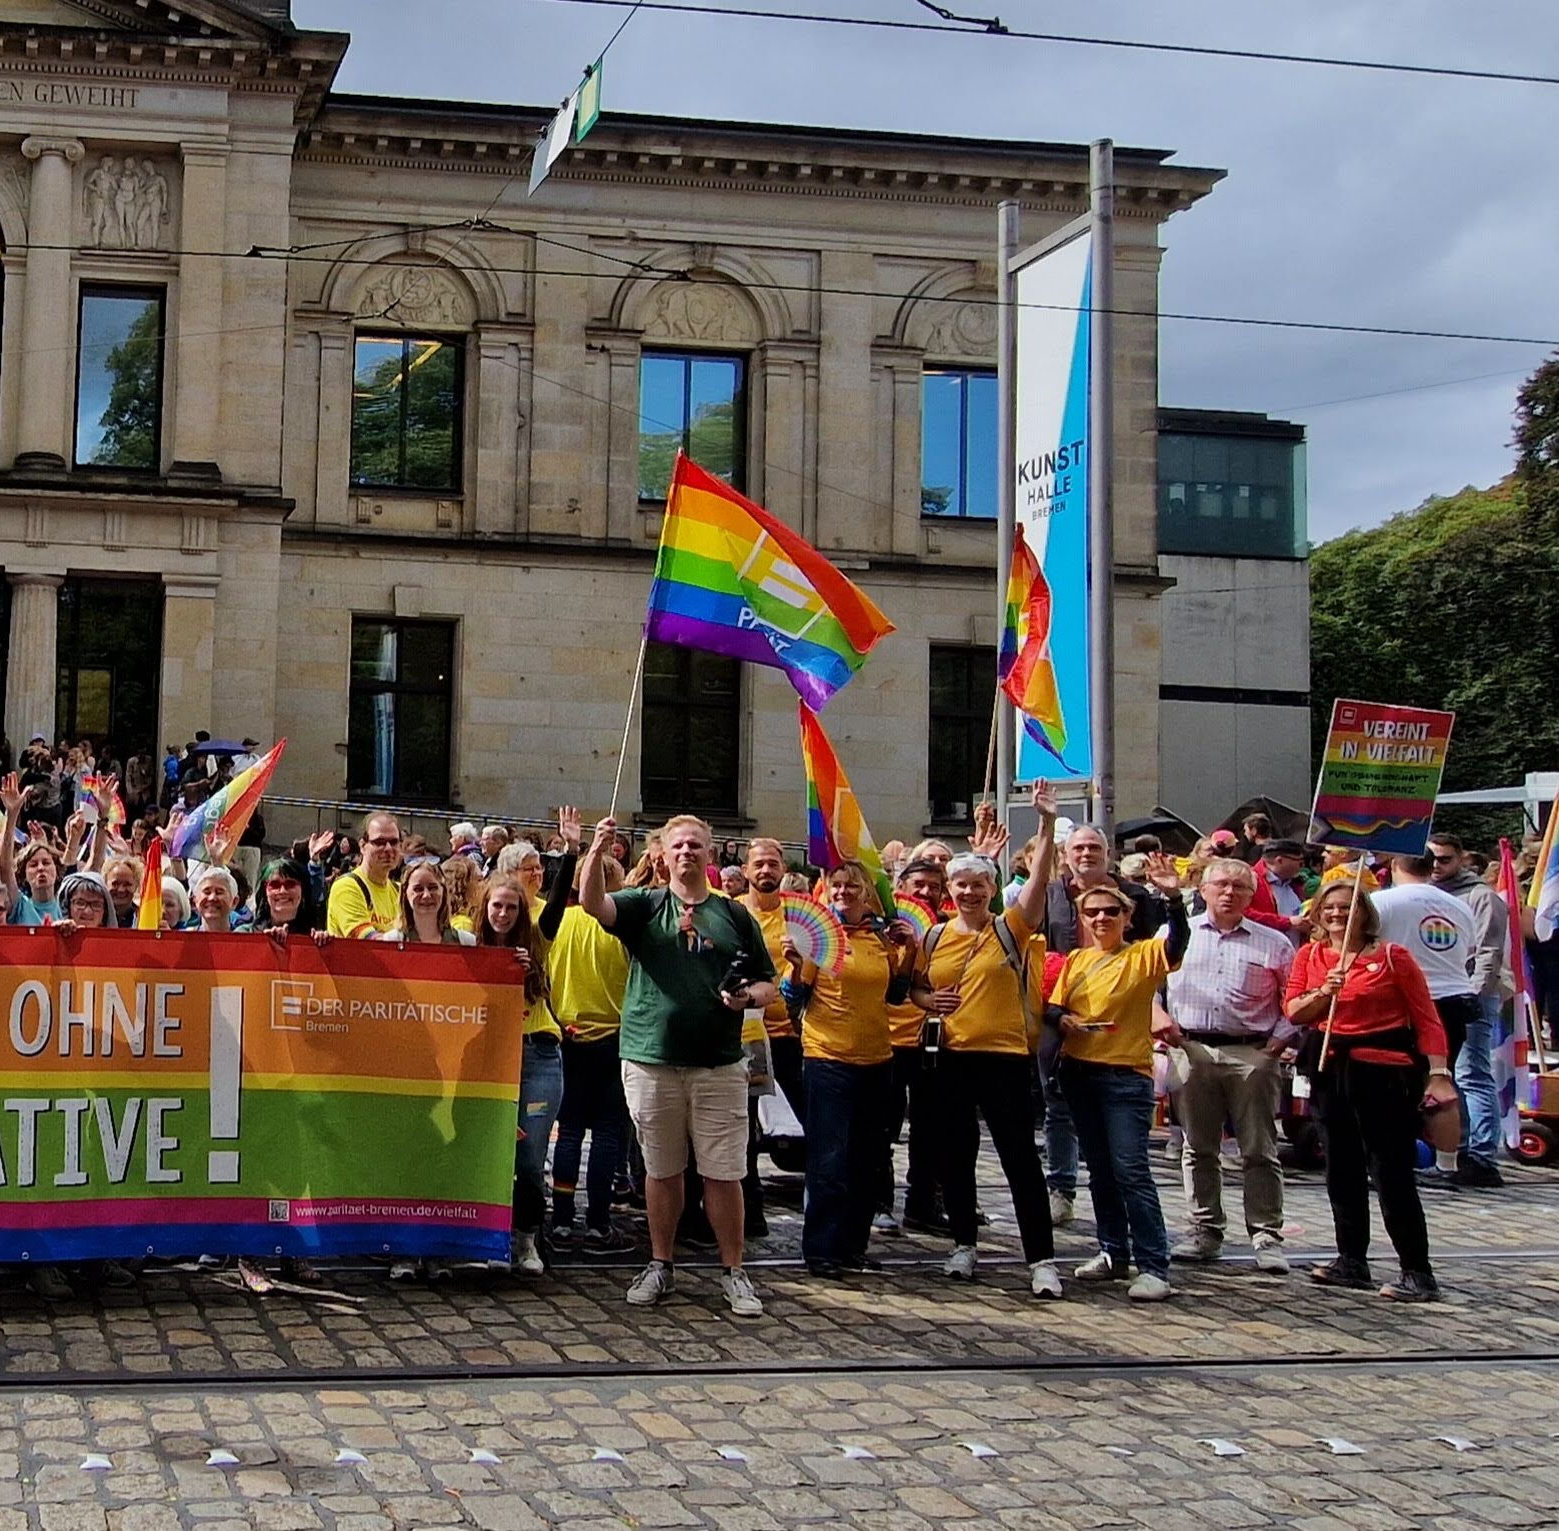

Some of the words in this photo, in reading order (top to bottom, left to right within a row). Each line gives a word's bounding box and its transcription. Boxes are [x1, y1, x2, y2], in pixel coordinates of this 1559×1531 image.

[34, 83, 140, 108] GEWEIHT
[1018, 440, 1084, 486] KUNST
[1028, 476, 1071, 505] HALLE
[1032, 501, 1067, 520] BREMEN
[1363, 720, 1431, 742] VEREINT
[1342, 741, 1358, 760] IN
[1366, 743, 1436, 764] VIELFALT
[9, 979, 185, 1057] OHNE
[306, 998, 345, 1018] DER
[349, 1000, 488, 1025] PARITÄTISCHE
[306, 1021, 349, 1033] Bremen
[295, 1203, 478, 1220] www.paritaet-bremen.de/vielfalt
